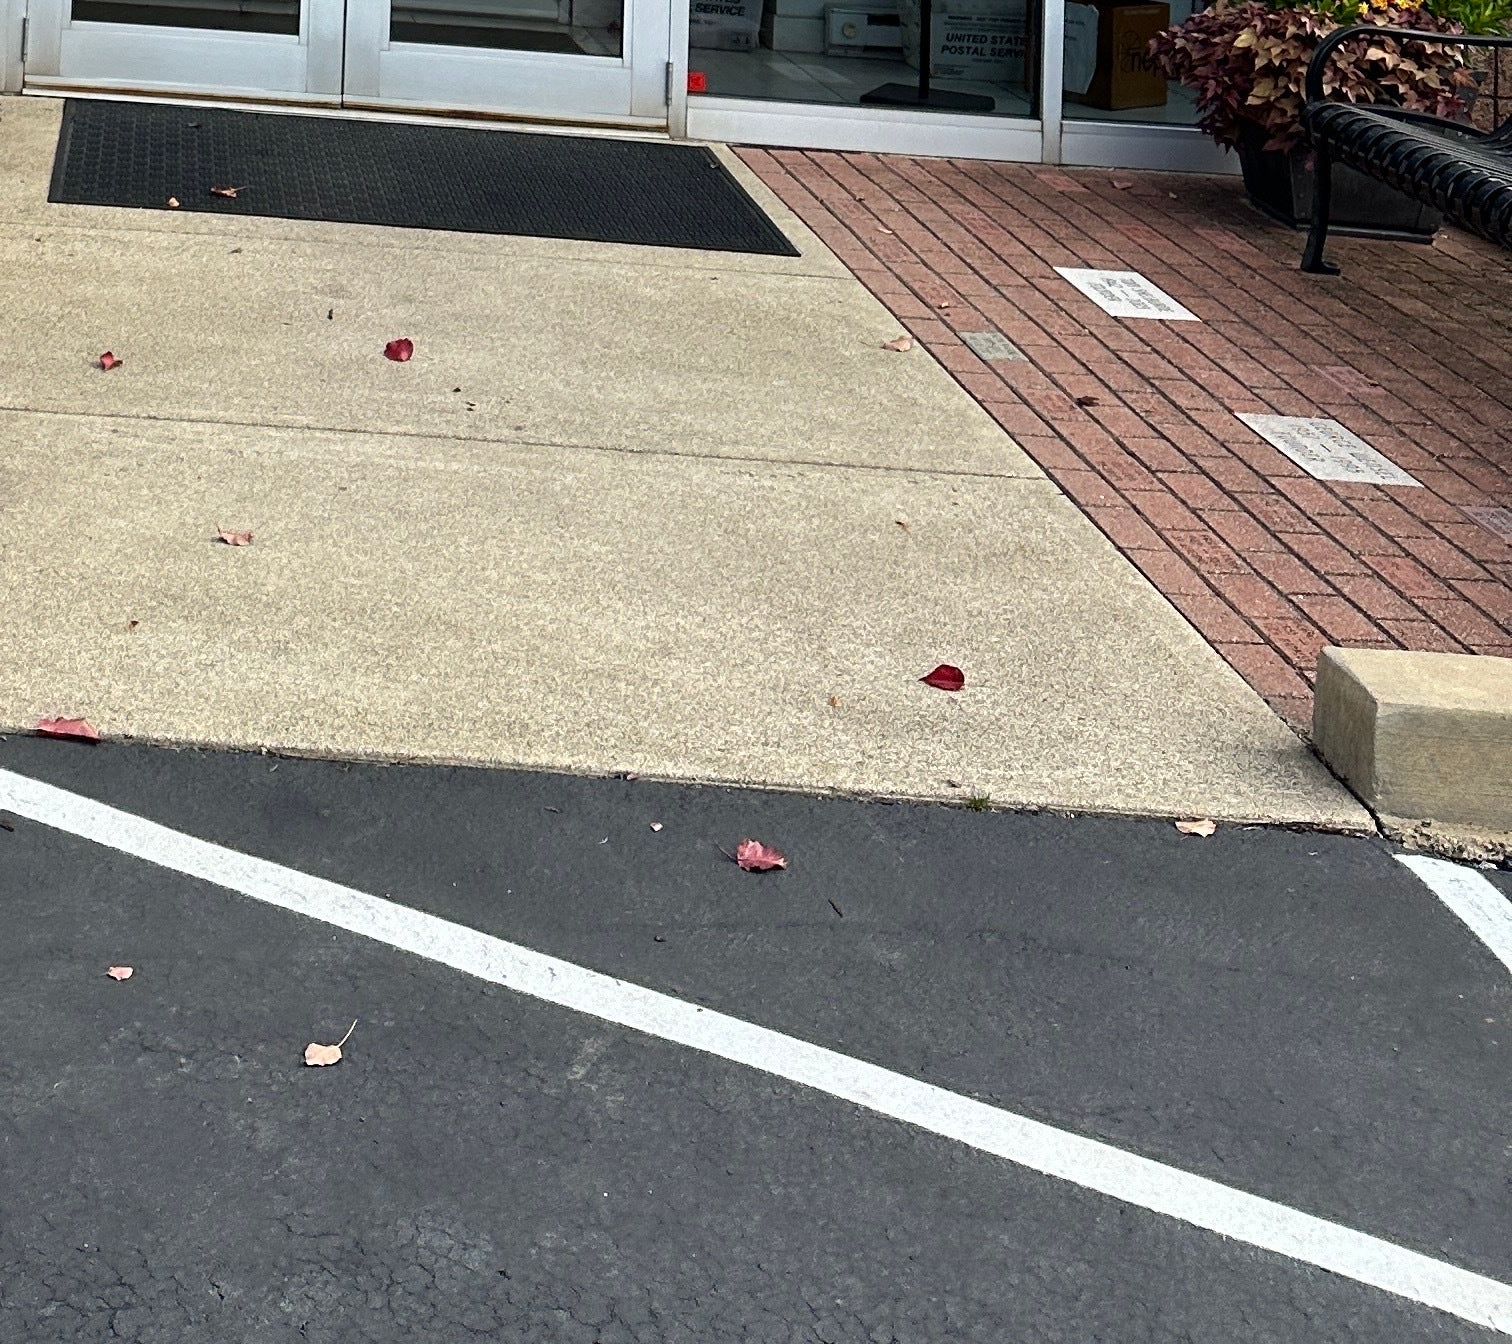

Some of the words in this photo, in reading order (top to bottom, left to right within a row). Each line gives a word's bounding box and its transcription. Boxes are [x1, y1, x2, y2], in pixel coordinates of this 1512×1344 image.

[694, 2, 746, 17] SERVICE
[945, 32, 988, 44] UNITED
[990, 35, 1026, 47] STATE
[940, 45, 987, 57] POSTAL
